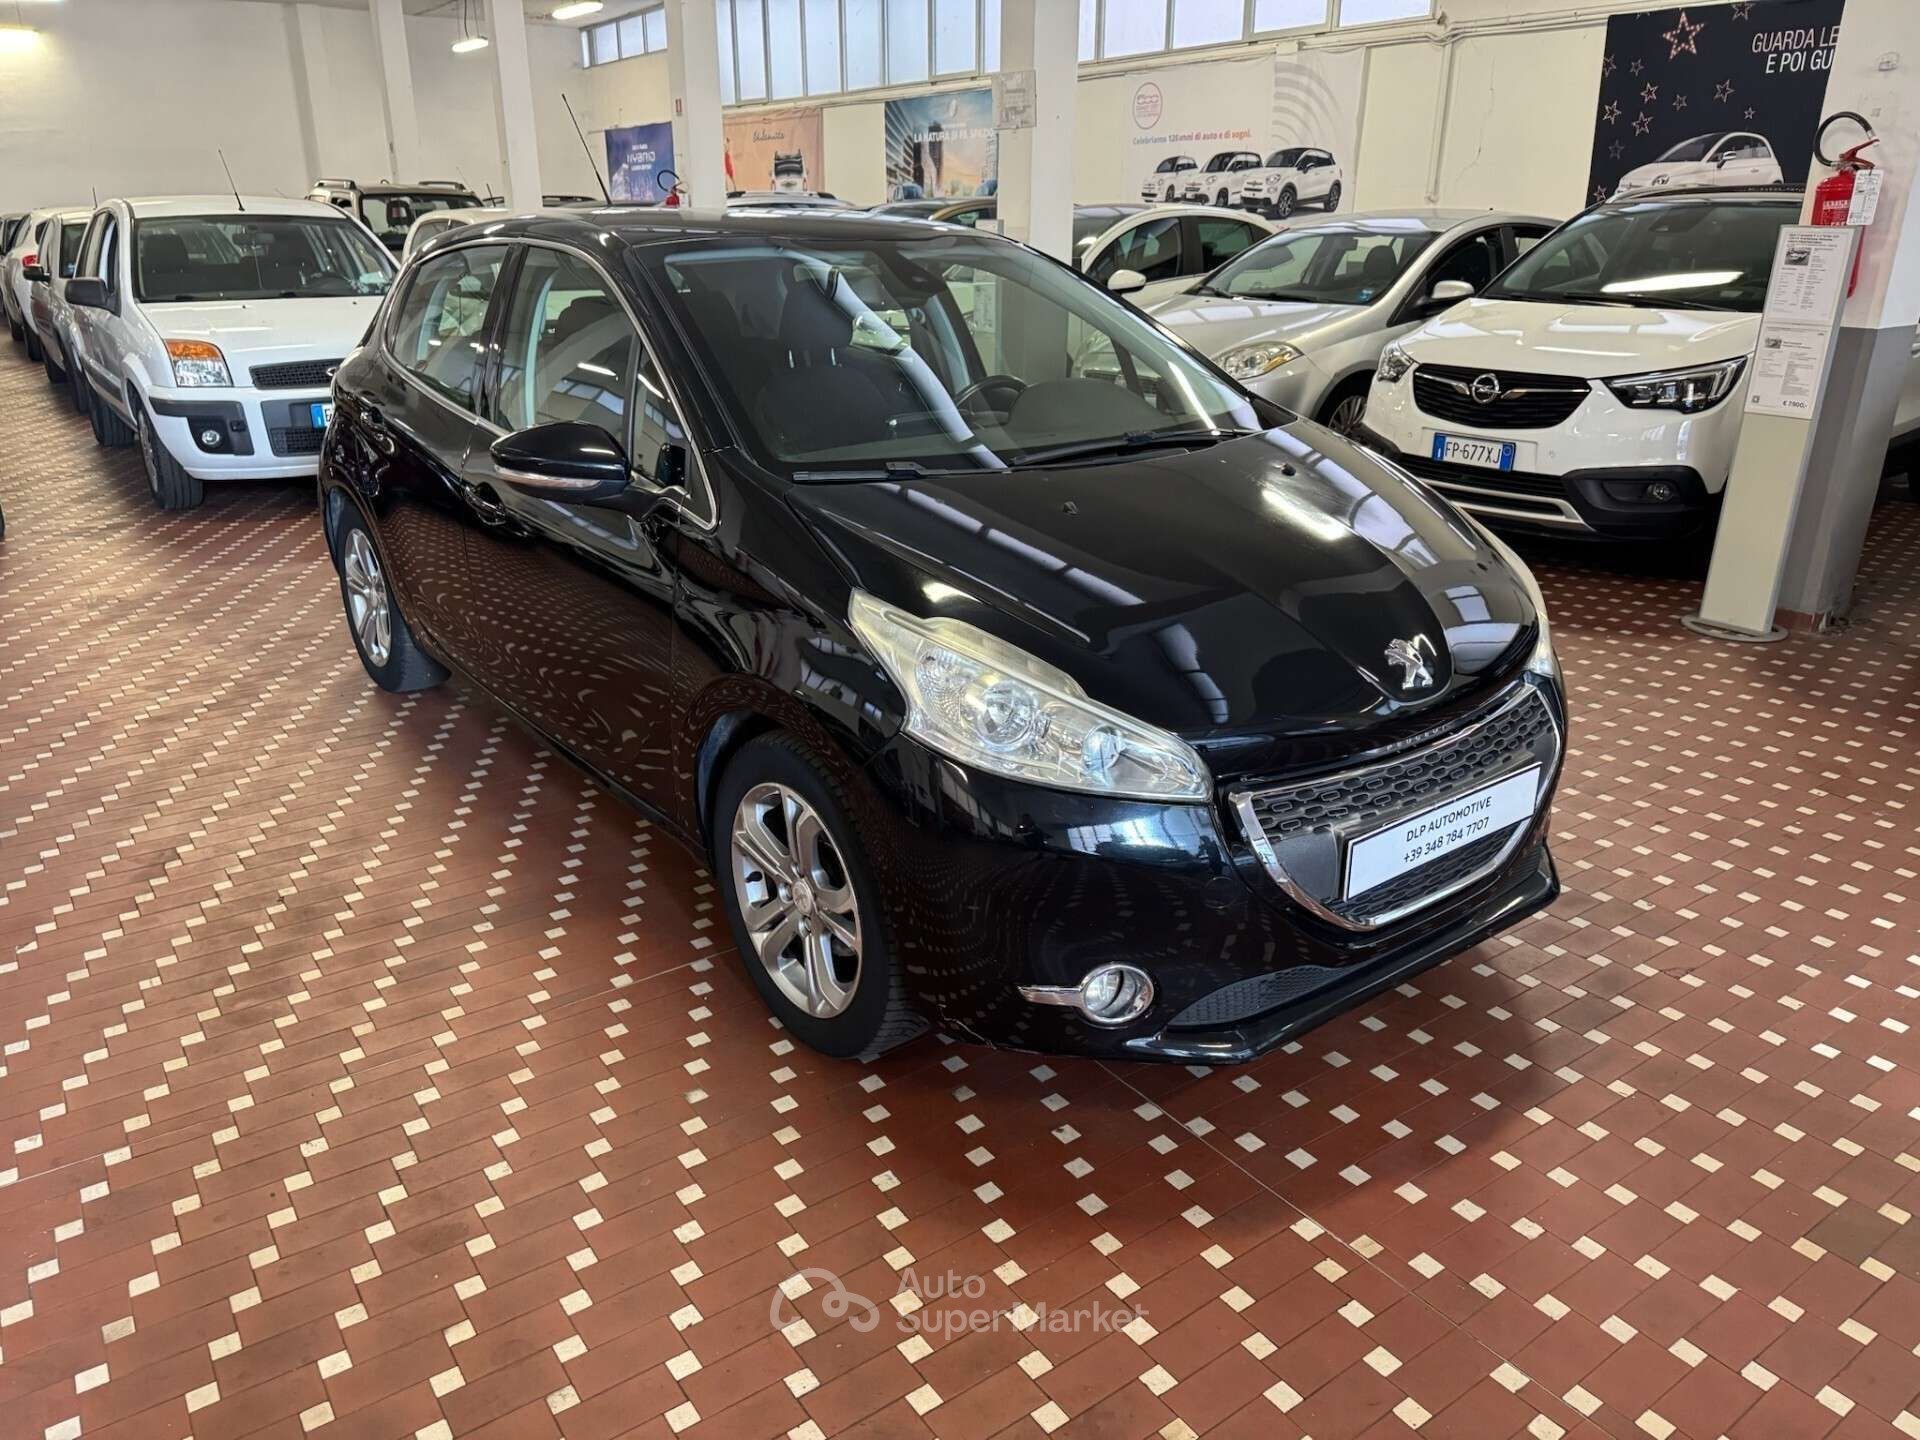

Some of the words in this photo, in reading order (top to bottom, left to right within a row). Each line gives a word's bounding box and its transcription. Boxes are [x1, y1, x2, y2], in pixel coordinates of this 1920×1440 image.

[1752, 28, 1815, 53] GUARDA
[1819, 25, 1840, 47] LE
[1766, 53, 1777, 73] E
[1780, 51, 1807, 72] POI
[1406, 824, 1427, 843] DLP
[1428, 796, 1492, 833] AUTOMOTIVE
[1404, 846, 1423, 863] +39
[1424, 836, 1444, 855] 348
[1446, 828, 1464, 845] 784
[1467, 816, 1490, 837] 7707
